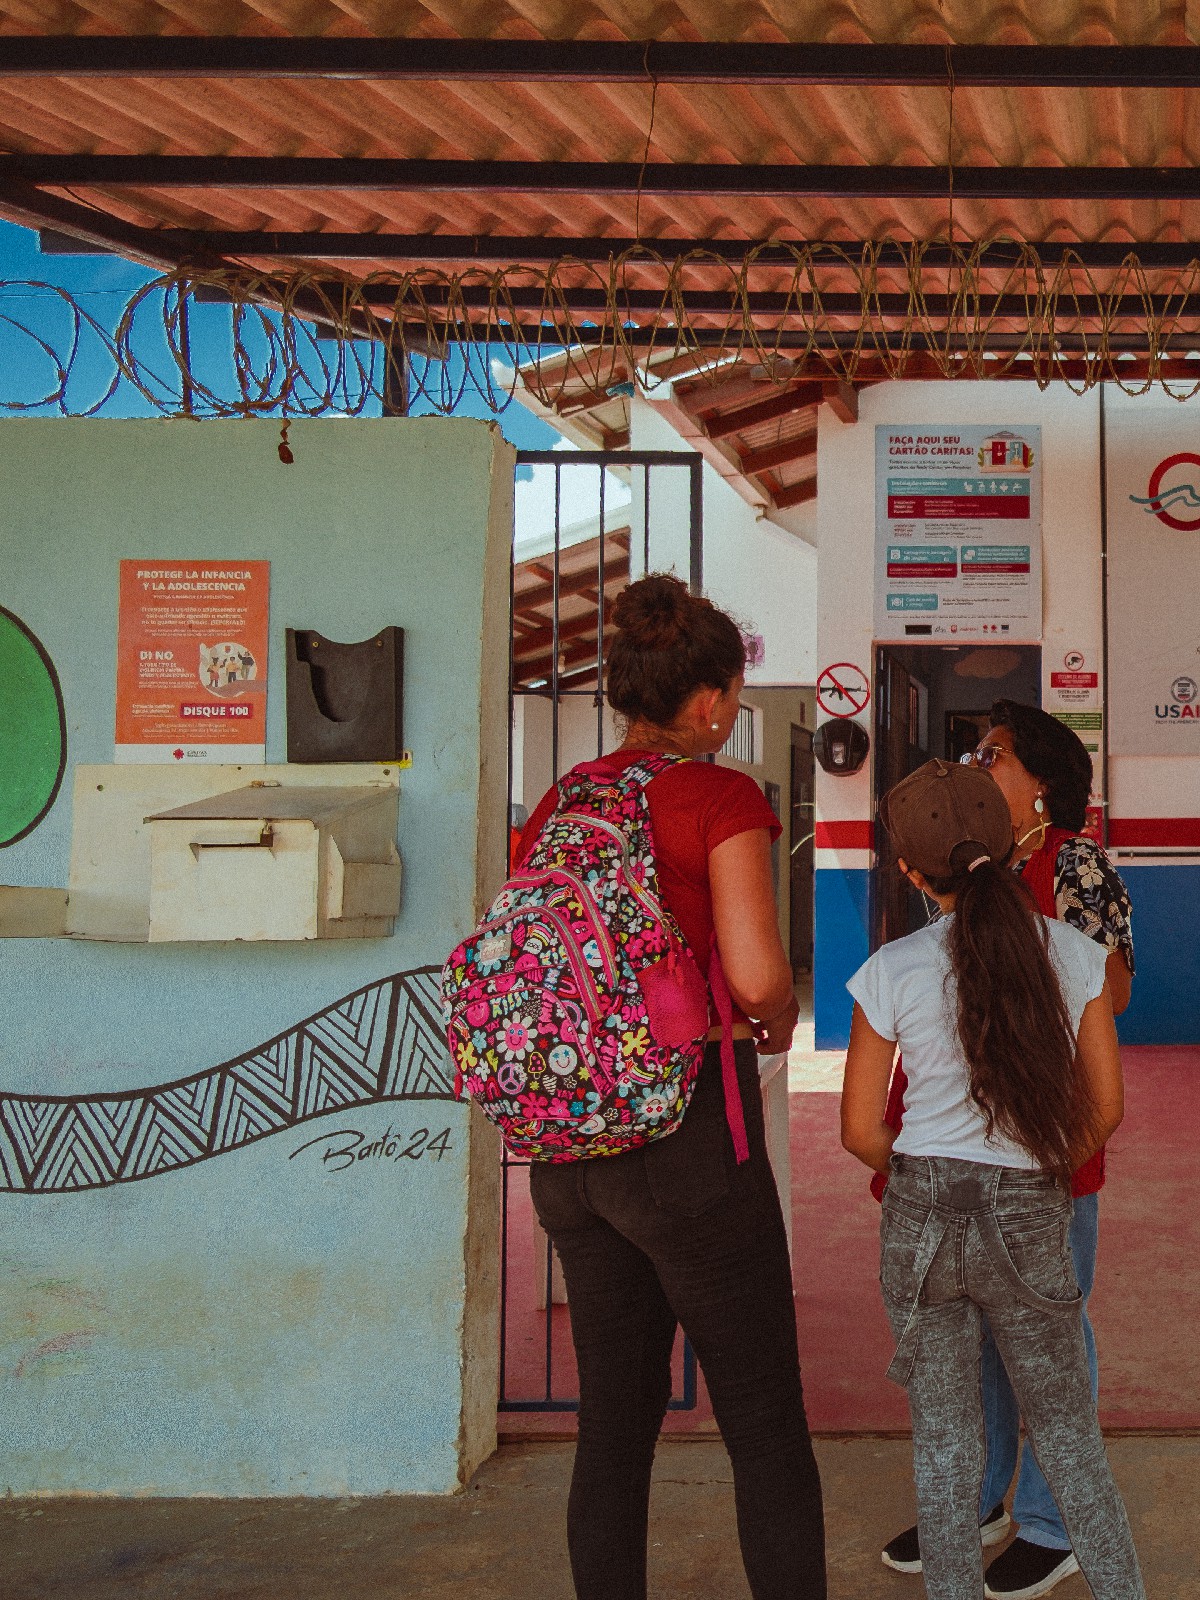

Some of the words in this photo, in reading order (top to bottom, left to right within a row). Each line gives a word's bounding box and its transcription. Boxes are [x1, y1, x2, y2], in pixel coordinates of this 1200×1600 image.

[889, 436, 914, 446] FAÇA
[916, 436, 940, 445] AQUI
[943, 436, 960, 444] SEU
[889, 445, 928, 455] CARTÃO
[137, 570, 183, 579] PROTEGE
[185, 570, 199, 579] LA
[201, 570, 252, 579] INFANCIA
[143, 582, 150, 591] Y
[152, 582, 166, 591] LA
[167, 582, 246, 591] ADOLESCENCIA
[140, 651, 152, 660] DI
[155, 651, 173, 660] NO
[183, 706, 226, 717] DISQUE
[229, 706, 249, 716] 100
